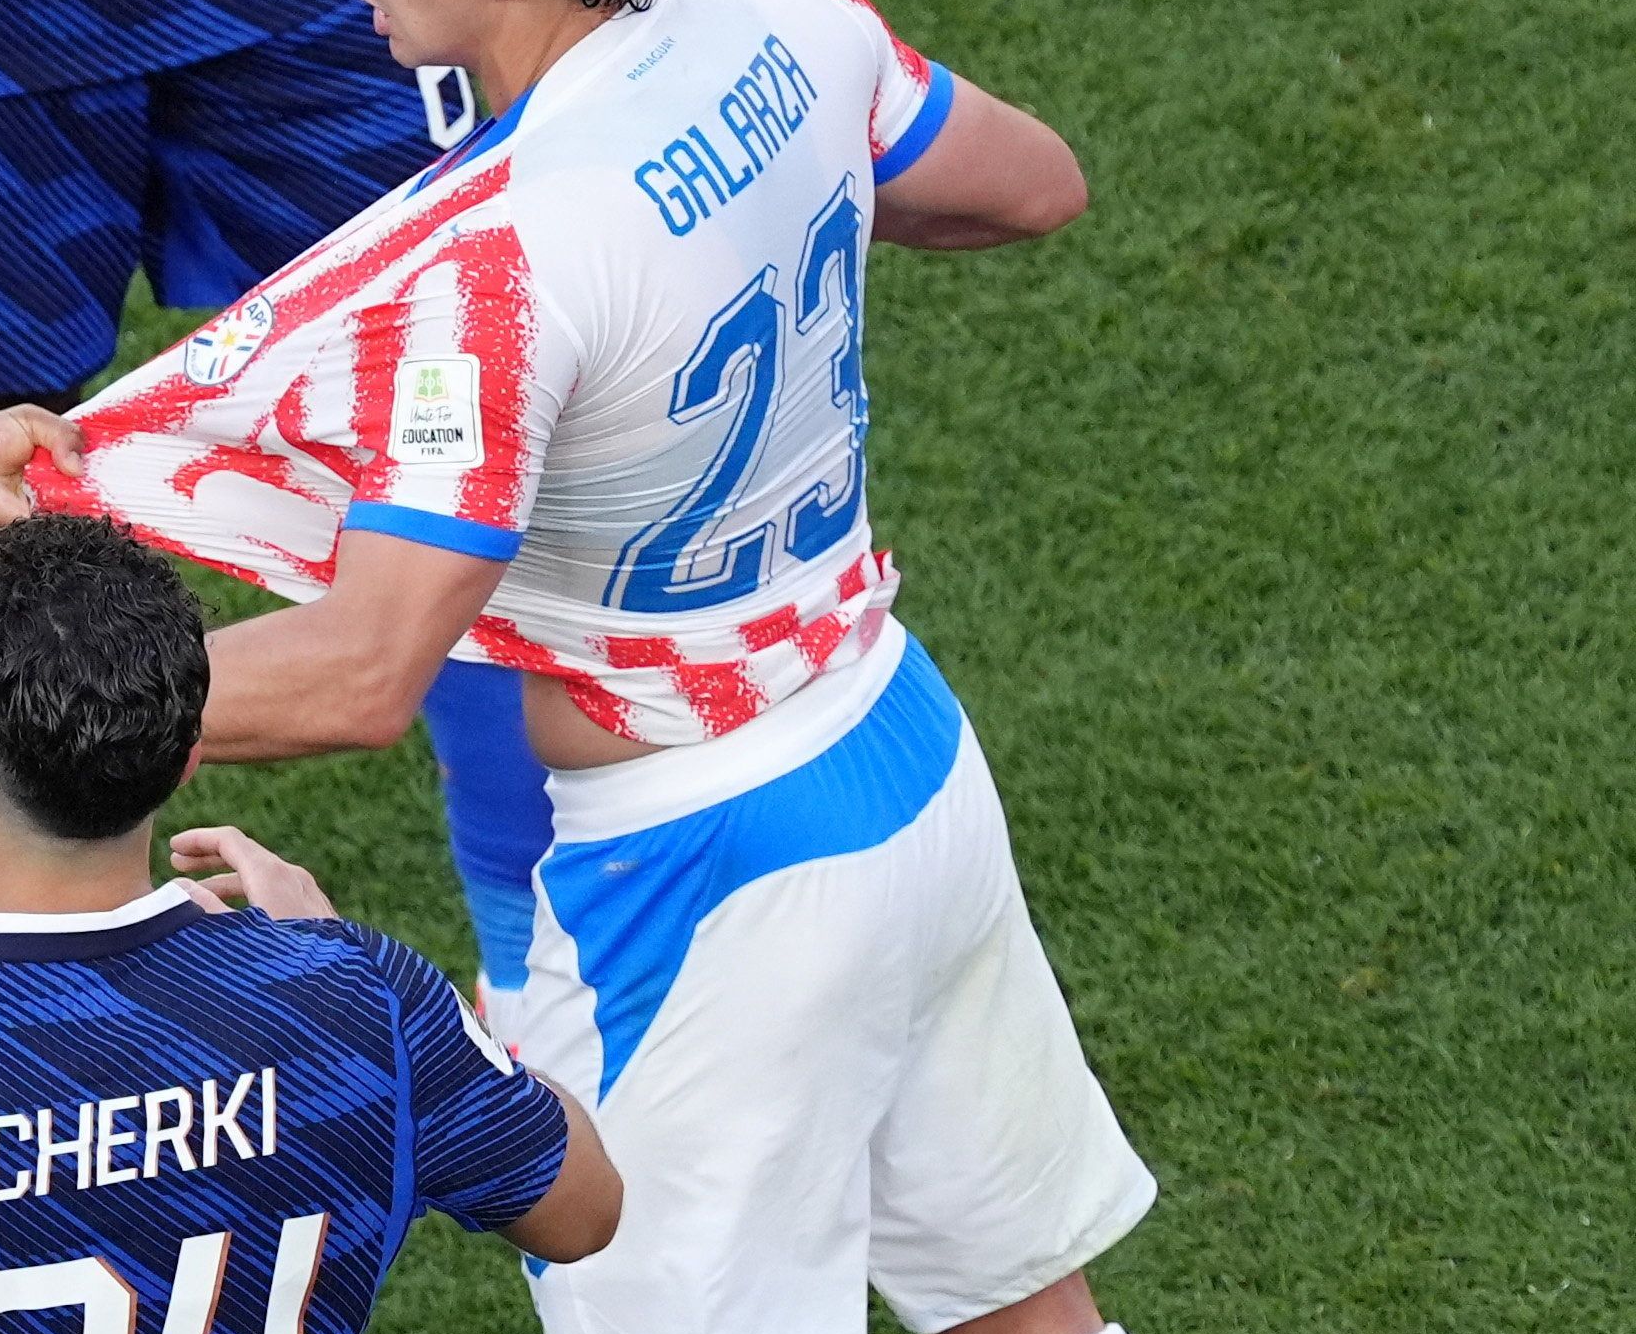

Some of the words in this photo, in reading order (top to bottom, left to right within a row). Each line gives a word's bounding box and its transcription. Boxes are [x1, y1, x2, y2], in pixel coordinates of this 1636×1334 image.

[625, 35, 677, 81] PARAGUAY
[634, 33, 818, 237] GALARZA
[601, 170, 870, 615] 23
[401, 426, 464, 445] EDUCATION
[420, 447, 445, 456] FIFA
